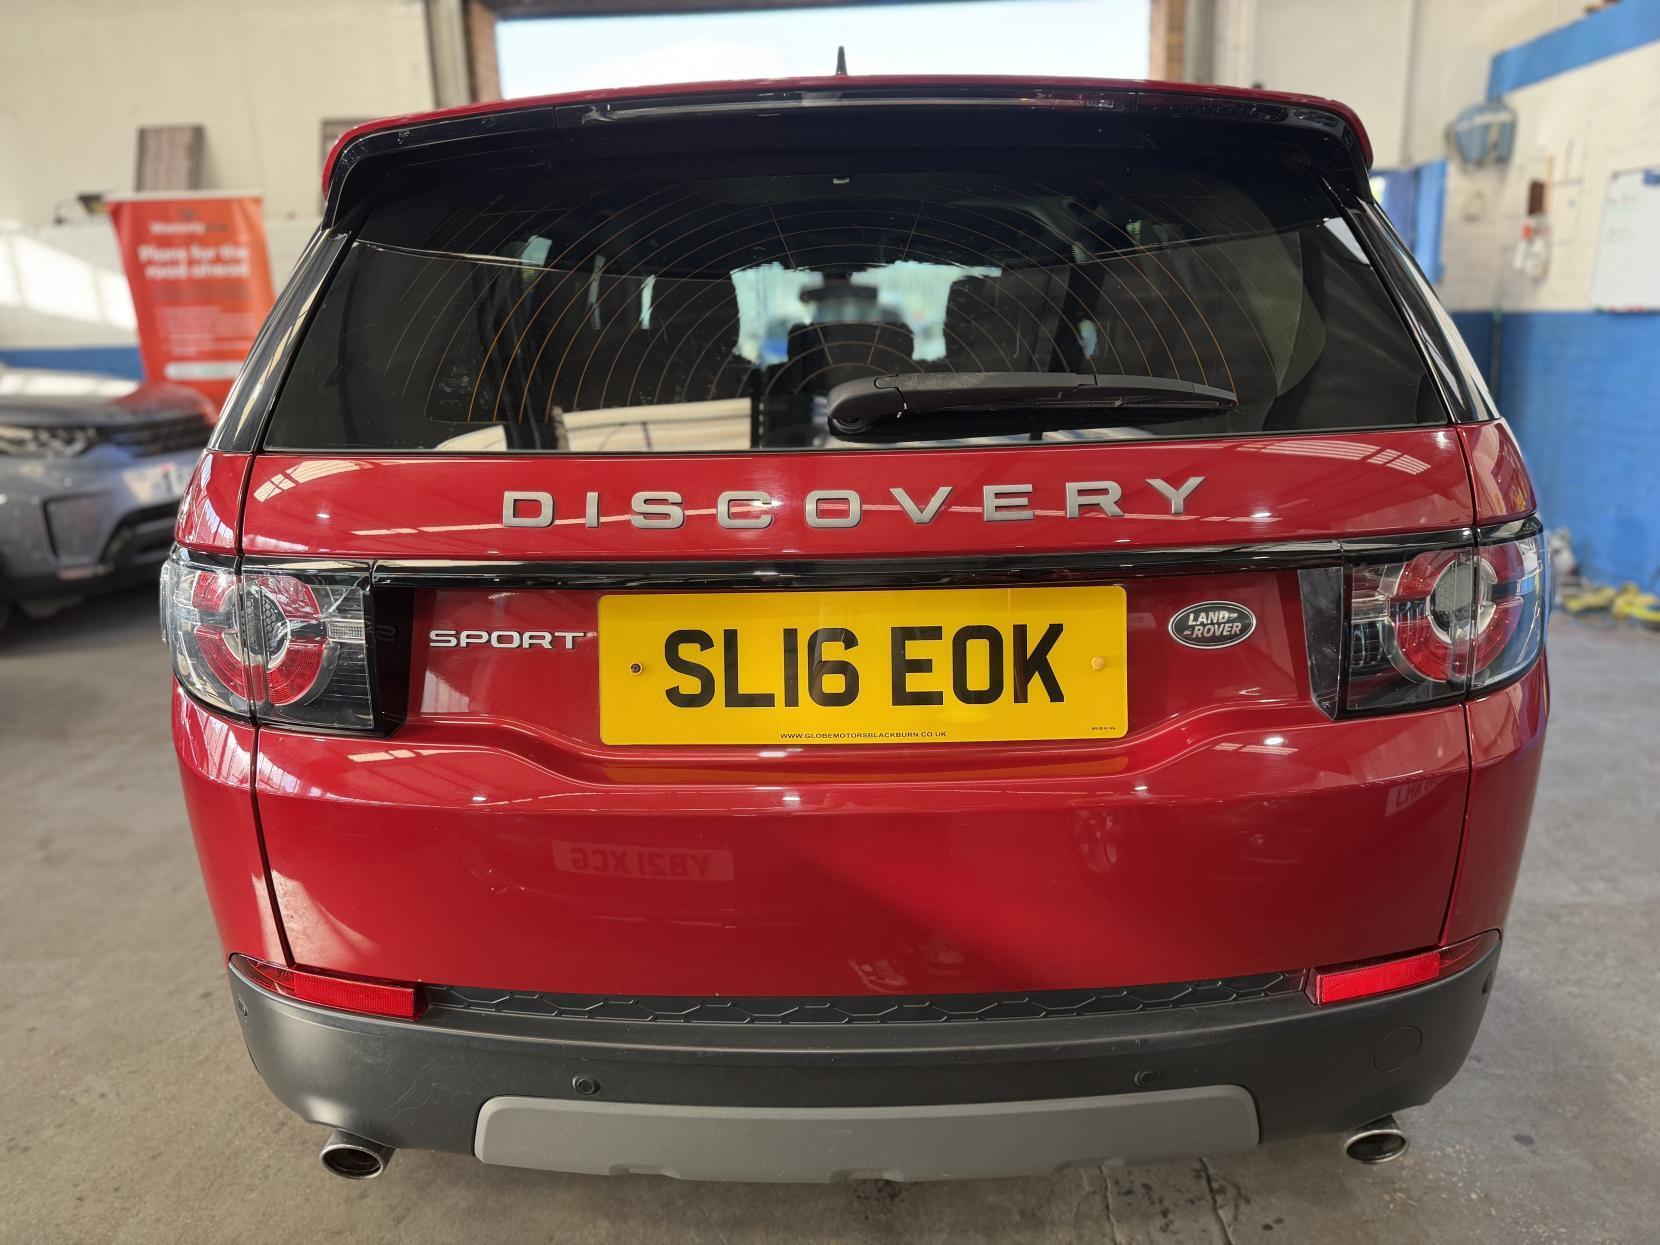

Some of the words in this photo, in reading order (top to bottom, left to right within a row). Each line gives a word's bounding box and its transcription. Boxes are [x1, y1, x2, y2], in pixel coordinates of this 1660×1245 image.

[502, 476, 1206, 530] DISCOVERY
[1188, 610, 1230, 626] LAND
[1192, 622, 1242, 638] ROVER
[429, 630, 585, 649] SPORT
[664, 627, 860, 708] SL16
[890, 623, 1065, 706] EOK
[780, 731, 948, 739] WWW.GLOBEMOTORSBLACKBURN.CO.UK
